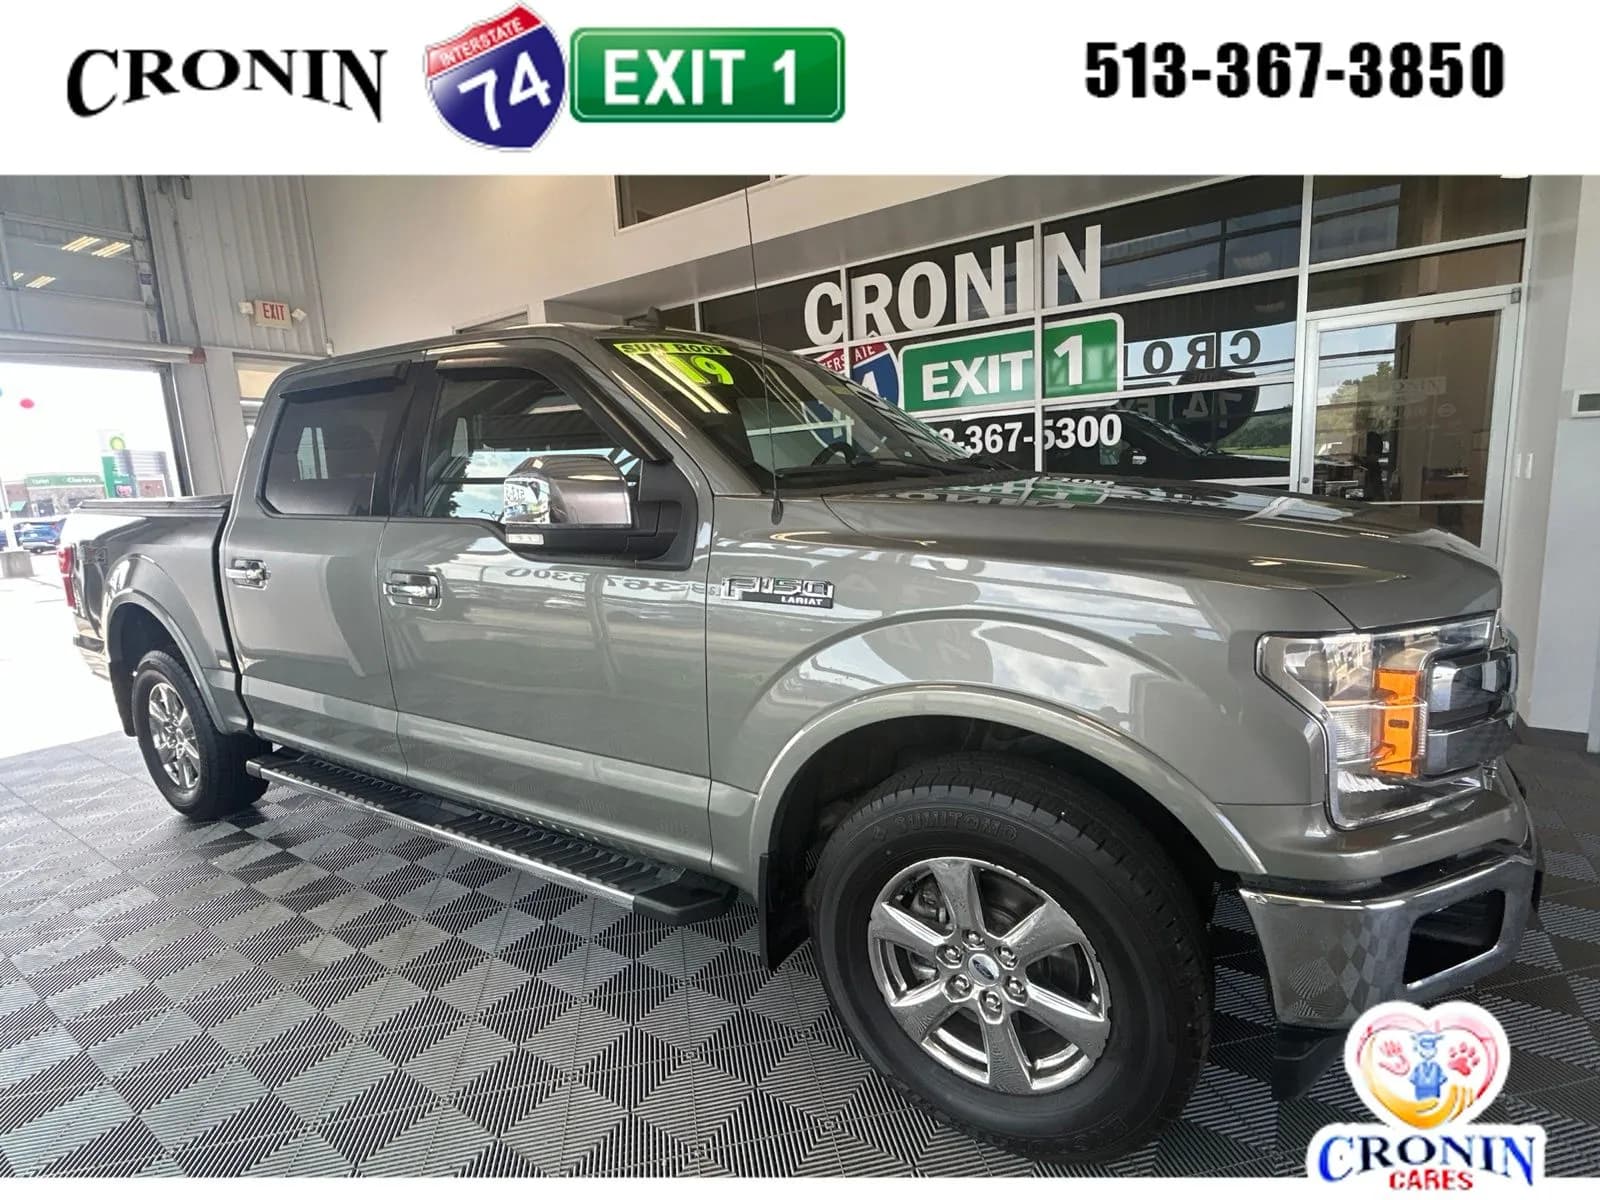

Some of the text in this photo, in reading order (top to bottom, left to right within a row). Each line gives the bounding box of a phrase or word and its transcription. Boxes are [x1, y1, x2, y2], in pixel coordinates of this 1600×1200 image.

[804, 224, 1101, 346] CRONIN
[262, 303, 285, 321] EXIT
[621, 343, 726, 354] SUN ROOF
[922, 350, 1033, 401] EXIT
[1054, 334, 1083, 386] 1
[781, 596, 824, 606] LARIAT
